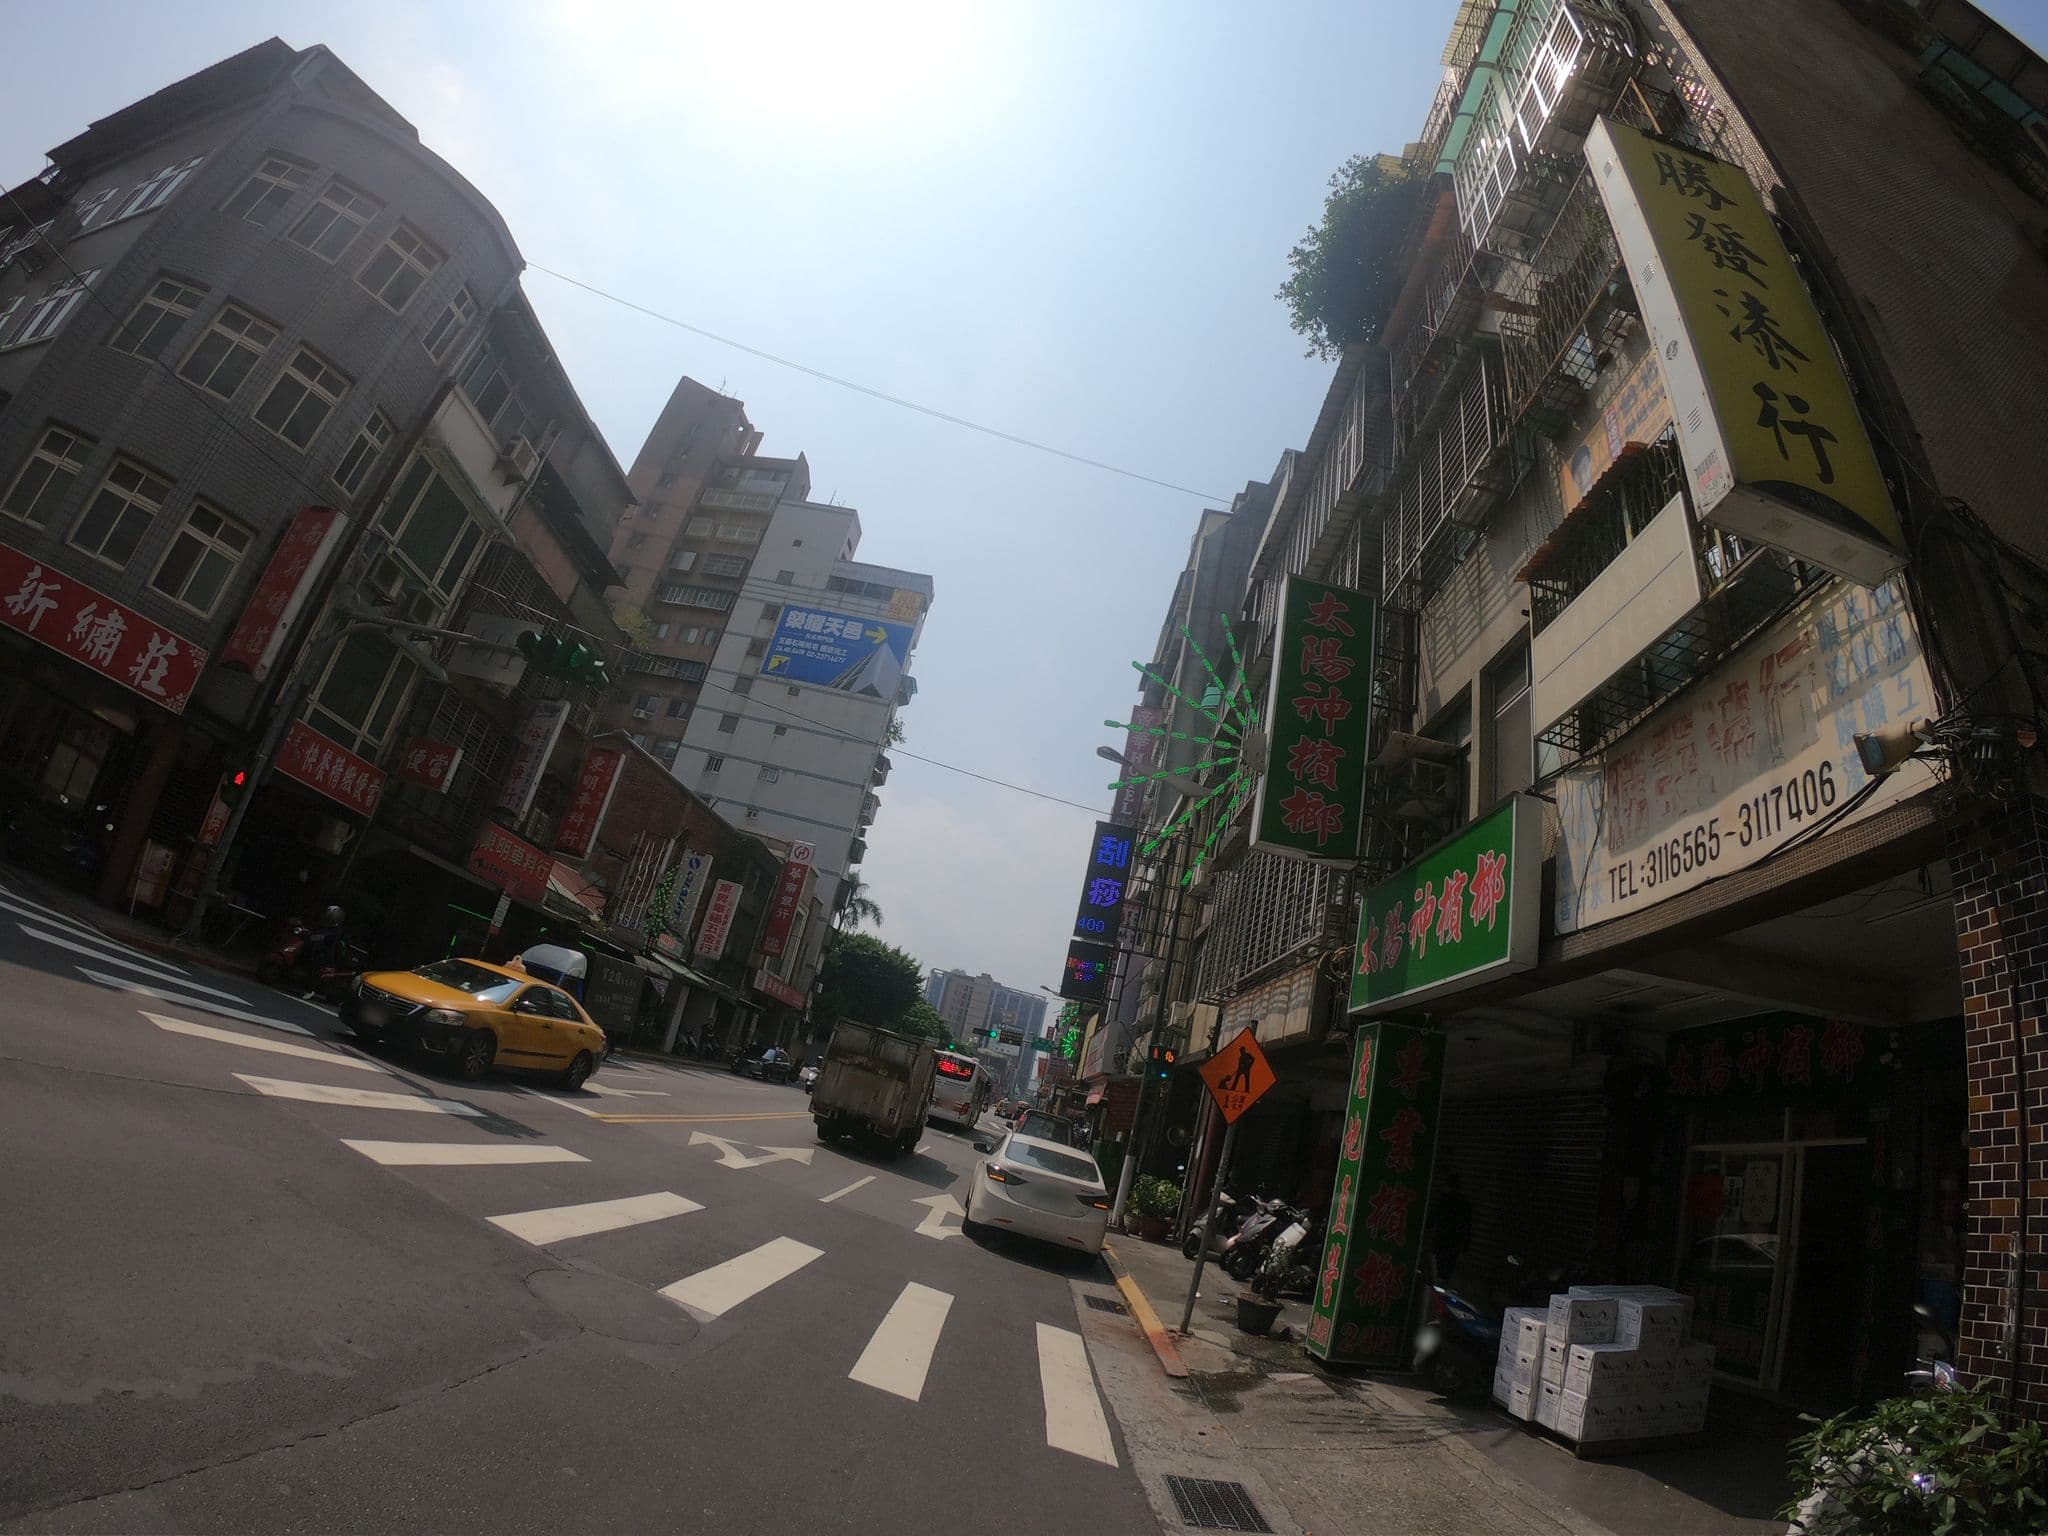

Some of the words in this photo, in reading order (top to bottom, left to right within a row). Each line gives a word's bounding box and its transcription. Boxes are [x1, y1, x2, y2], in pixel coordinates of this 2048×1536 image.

[1651, 151, 1838, 485] 勝發漆行
[3, 564, 182, 697] 新繡莊
[1279, 591, 1356, 847] 太陽神檳榔
[407, 748, 449, 779] 便當
[1357, 849, 1506, 977] 太陽神檳榔
[1353, 1038, 1432, 1317] 專業檳榔
